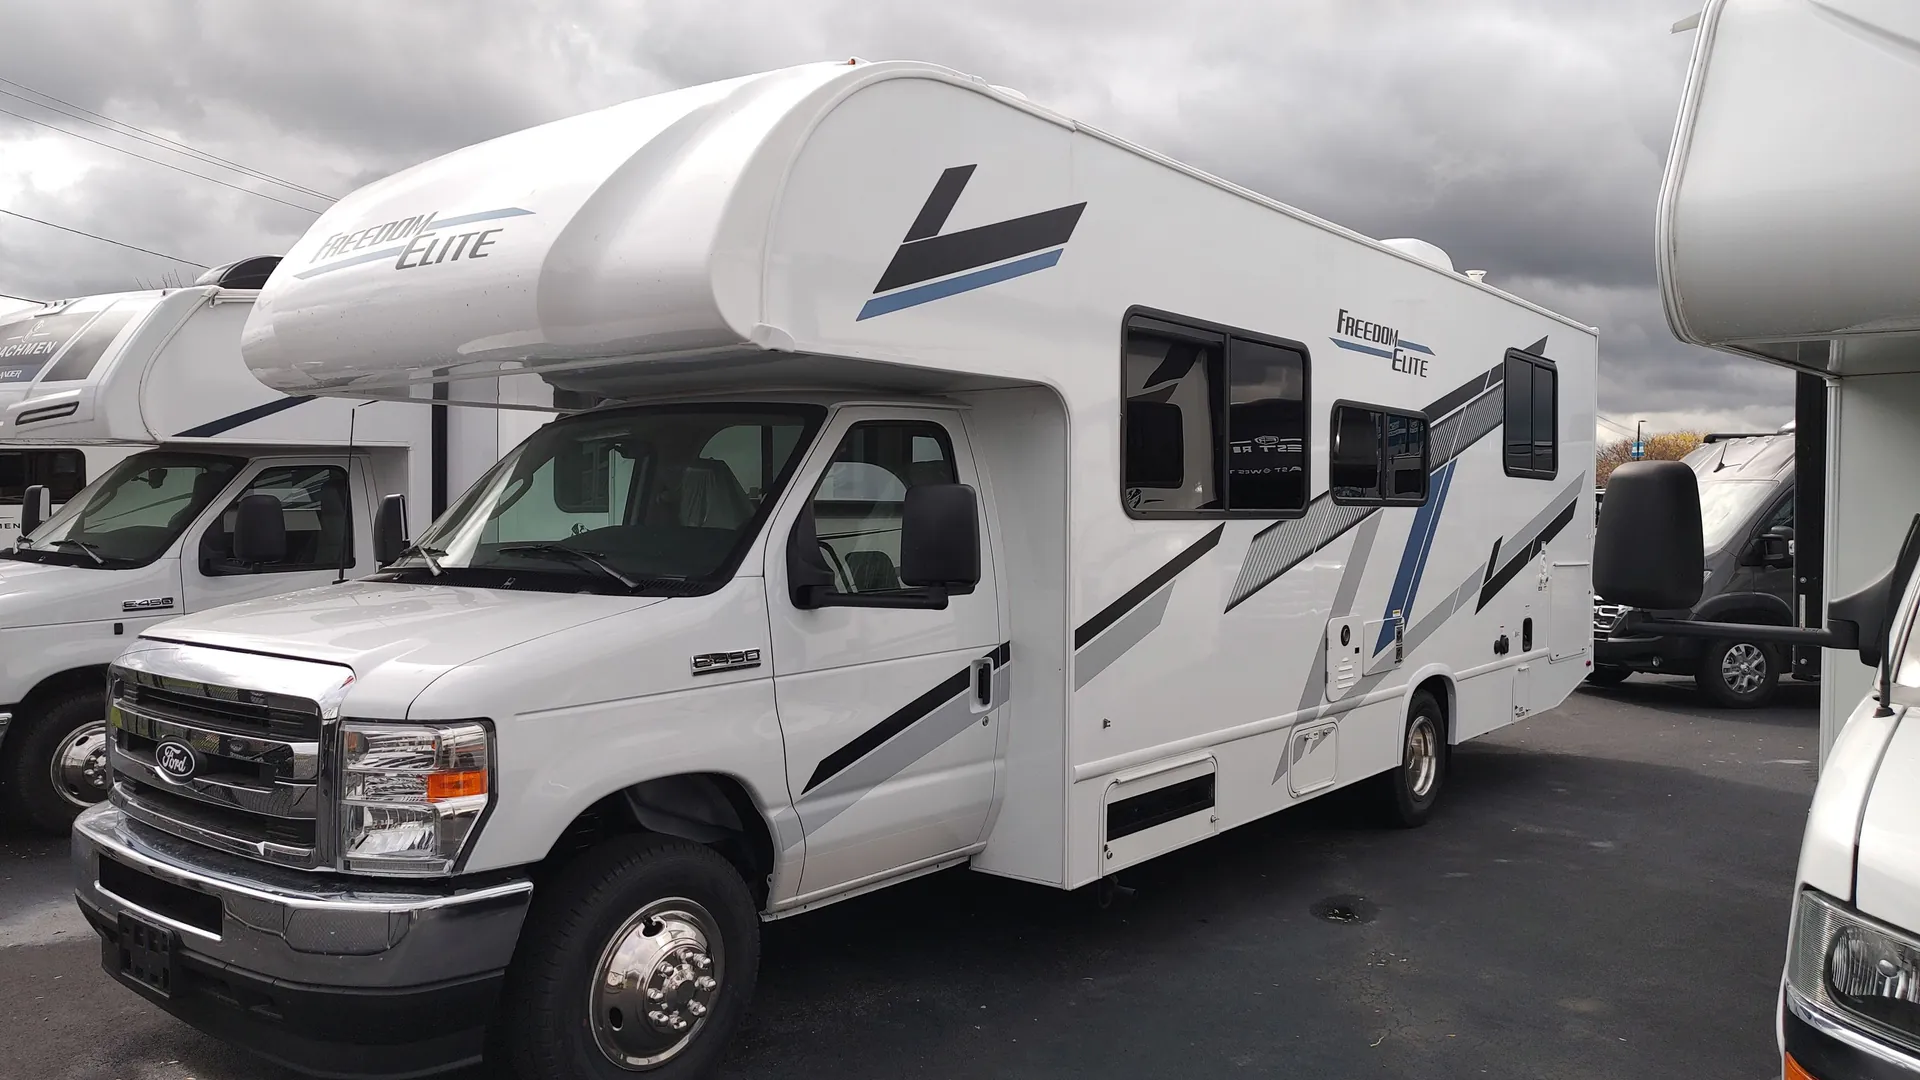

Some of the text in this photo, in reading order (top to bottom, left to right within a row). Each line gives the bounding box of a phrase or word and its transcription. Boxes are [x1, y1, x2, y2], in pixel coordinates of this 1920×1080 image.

[309, 211, 438, 264] FREEDOM
[395, 228, 503, 270] ELITE
[1337, 308, 1398, 347] FREEDOM
[0, 341, 57, 358] ACHMEN
[1391, 348, 1428, 378] ELITE
[162, 745, 187, 772] Ford
